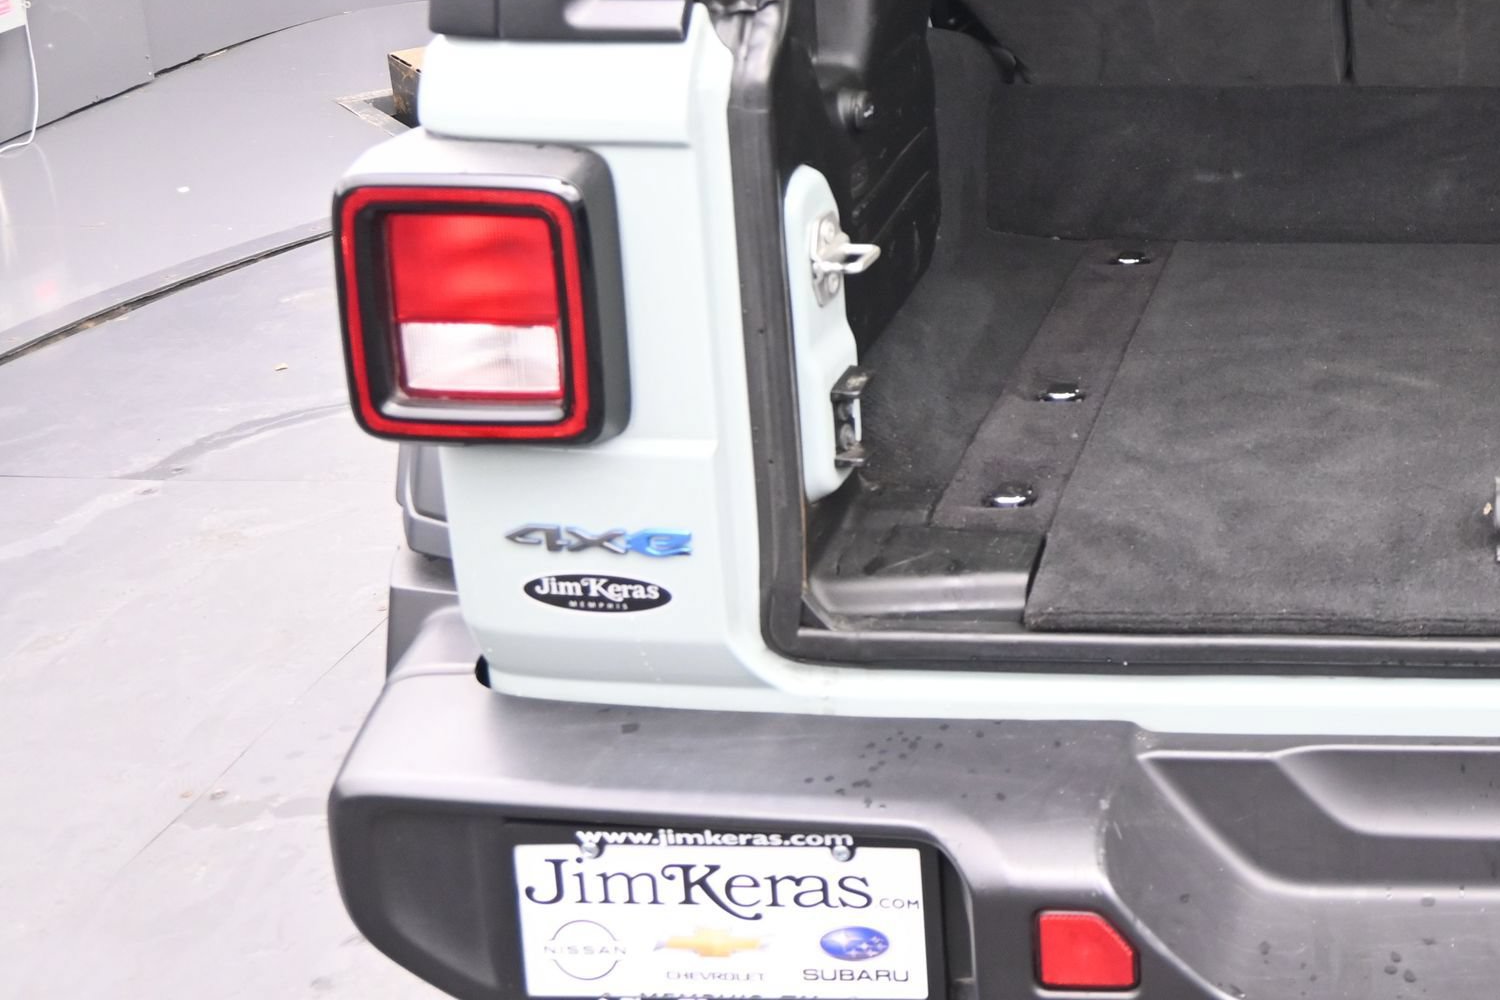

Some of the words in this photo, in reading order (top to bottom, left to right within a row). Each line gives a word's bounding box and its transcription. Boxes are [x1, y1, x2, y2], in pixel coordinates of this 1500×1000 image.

[567, 600, 629, 611] MEMPHIS
[576, 829, 854, 847] www.jimkeras.com
[543, 945, 627, 956] NISSAN
[666, 970, 767, 983] CHEVROLET
[803, 969, 909, 983] SUBARU
